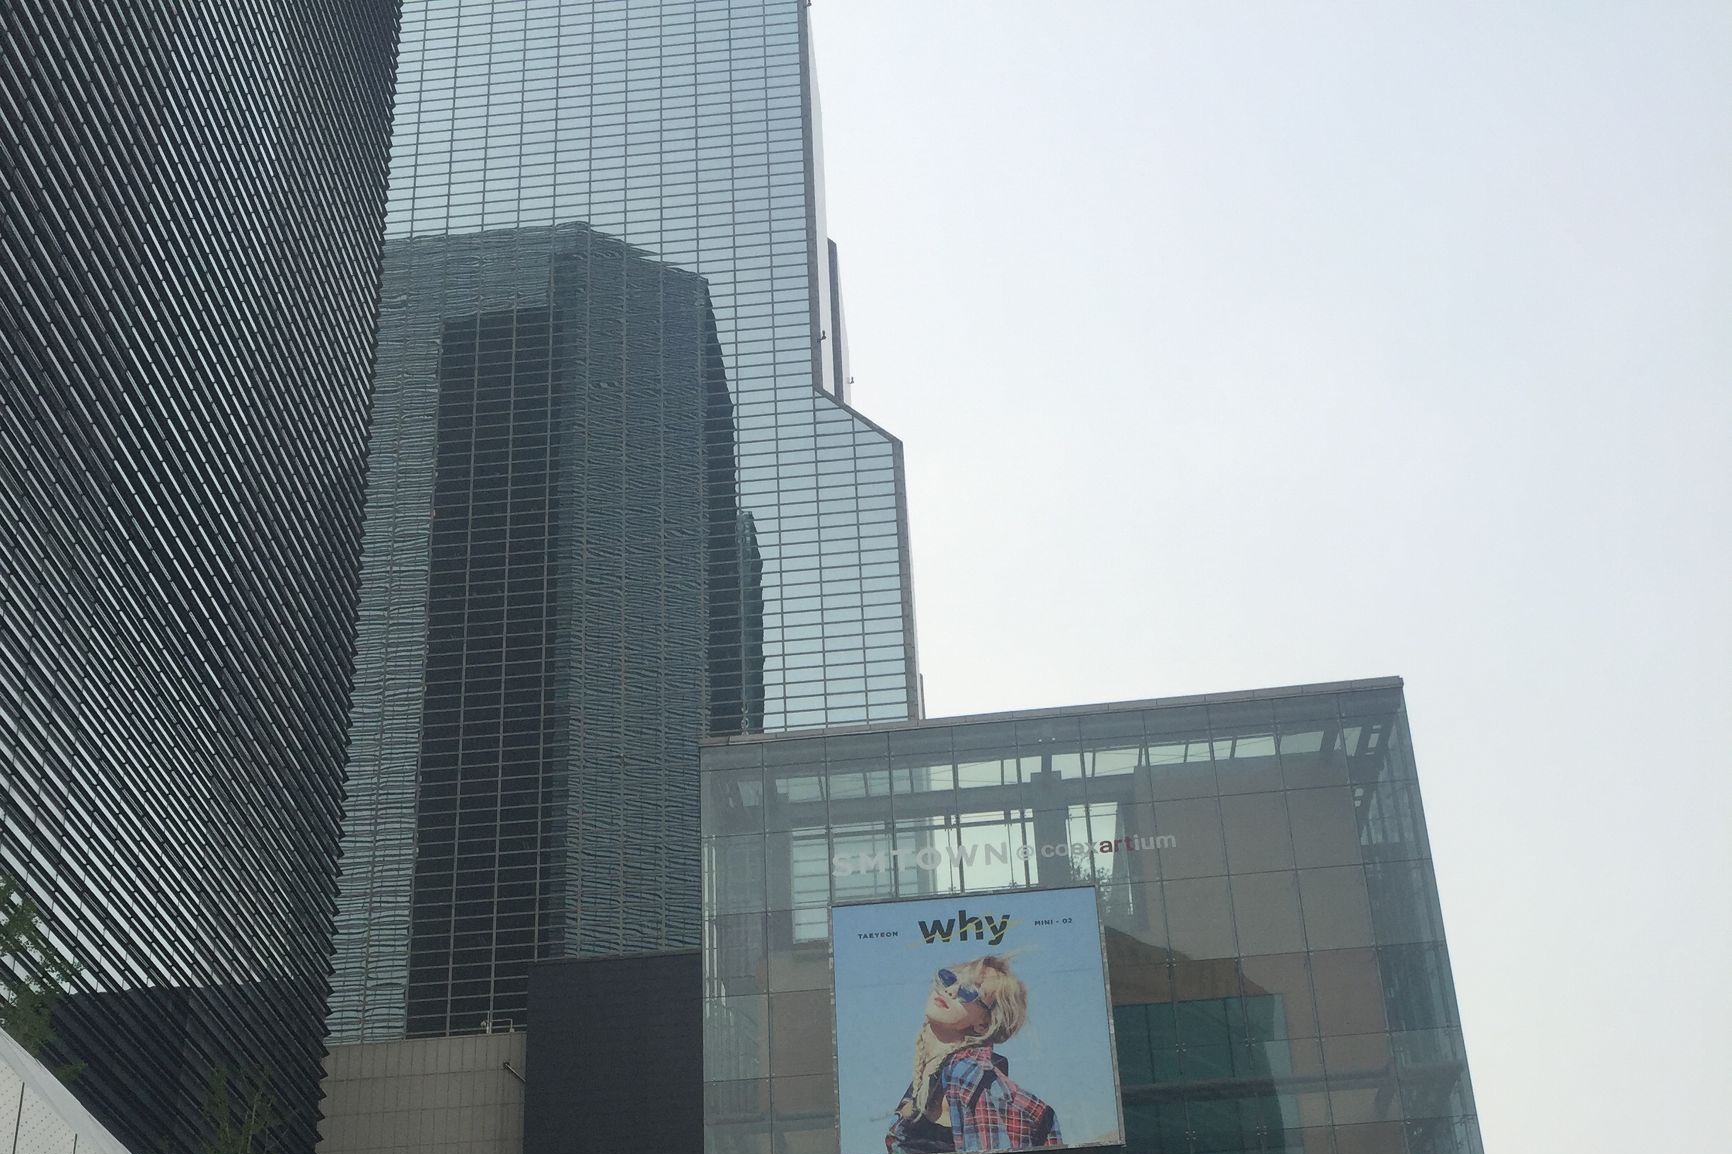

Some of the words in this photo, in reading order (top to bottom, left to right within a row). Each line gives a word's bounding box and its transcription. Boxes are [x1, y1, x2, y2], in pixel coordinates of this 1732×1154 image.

[832, 841, 1008, 877] SMTOWN
[1041, 834, 1177, 858] coexartium
[858, 931, 899, 940] TAEYEON
[918, 909, 1011, 945] why
